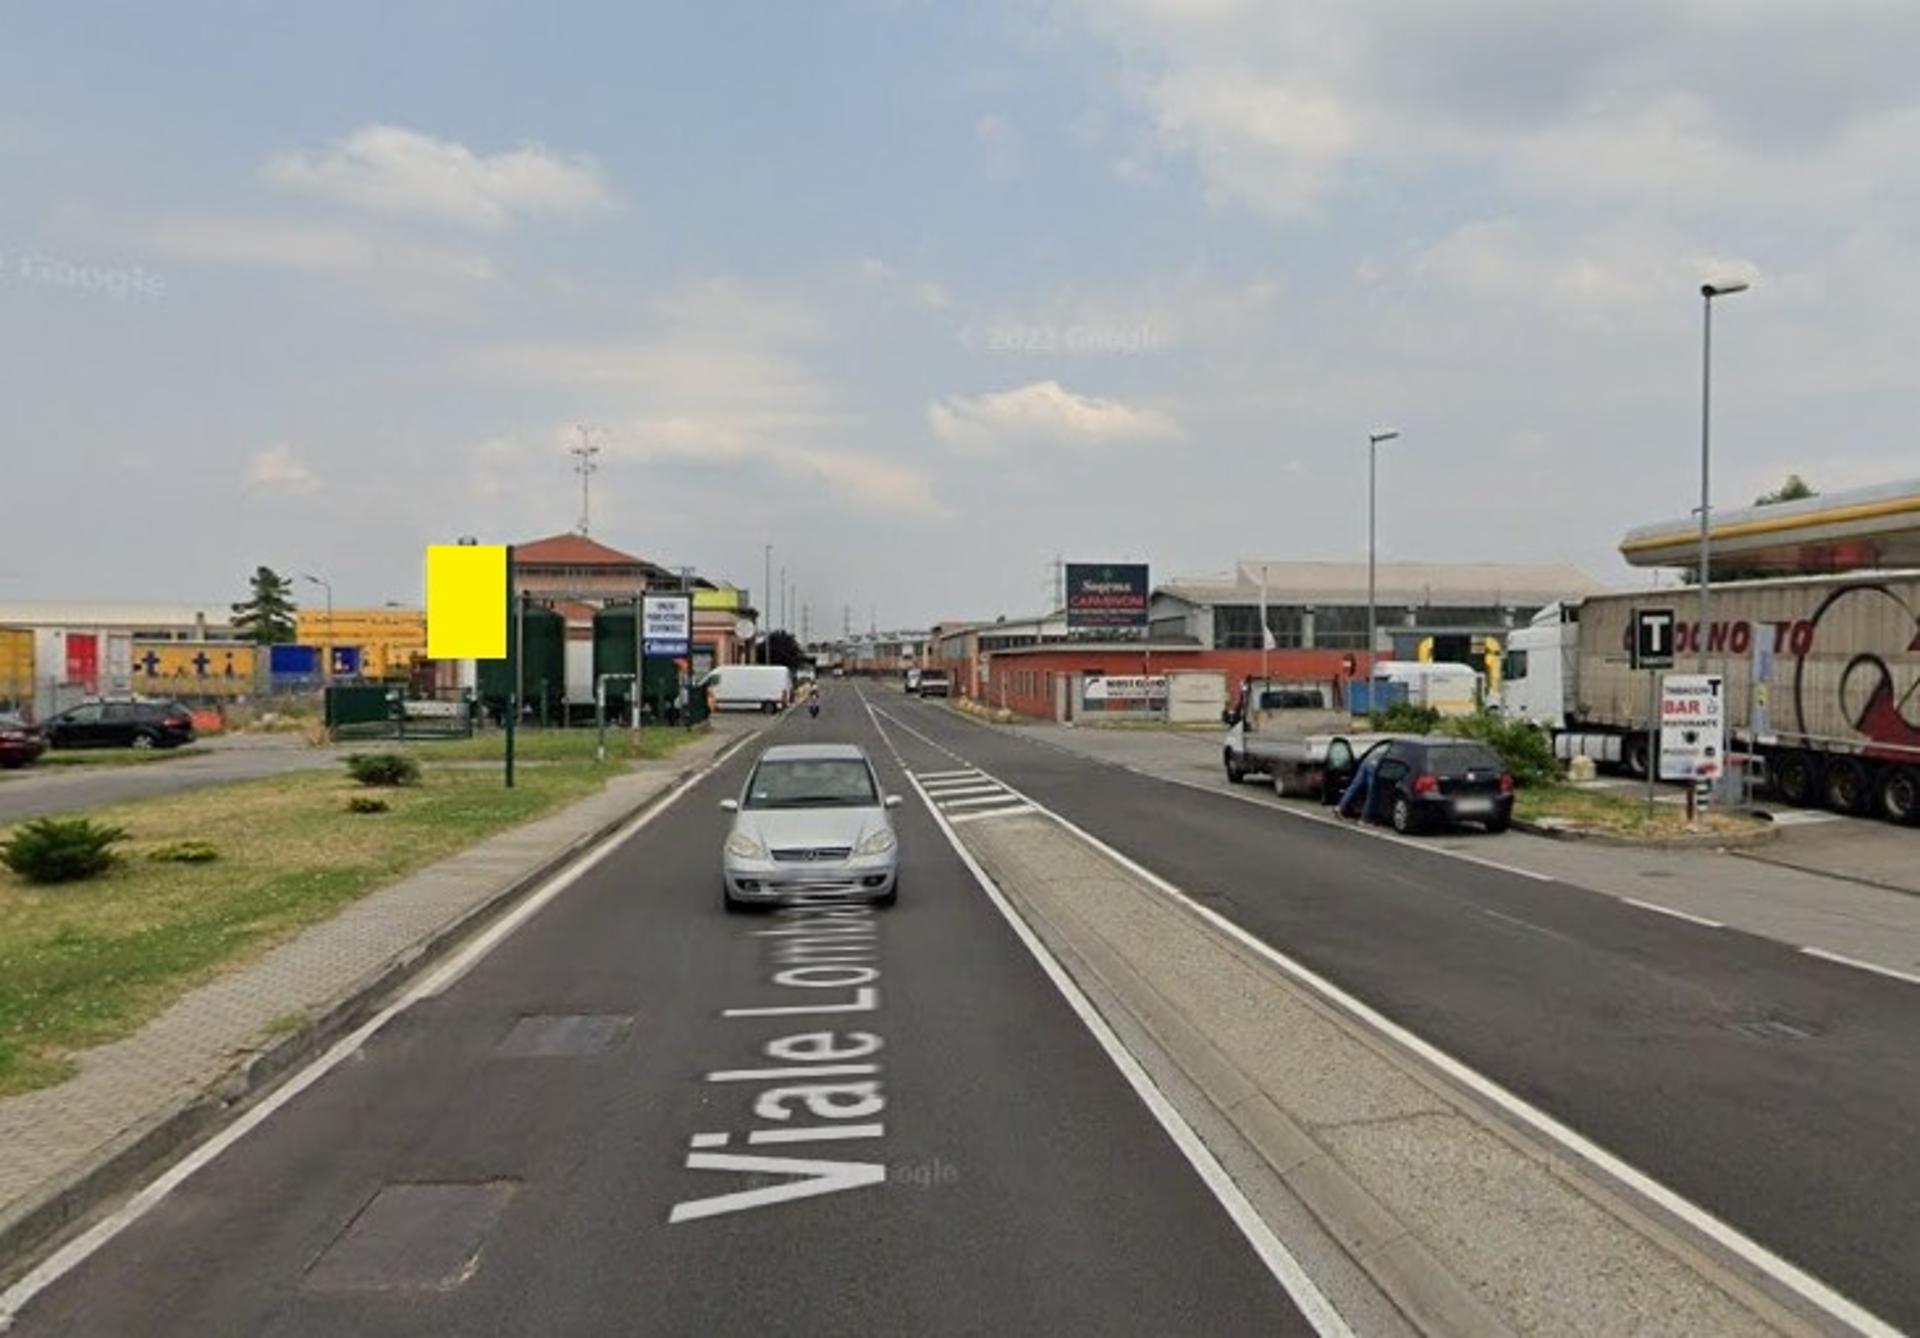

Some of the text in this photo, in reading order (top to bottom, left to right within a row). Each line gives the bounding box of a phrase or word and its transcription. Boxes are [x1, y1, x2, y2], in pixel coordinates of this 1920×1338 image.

[1642, 615, 1670, 651] T
[1707, 679, 1721, 696] T
[1664, 700, 1700, 715] BAR
